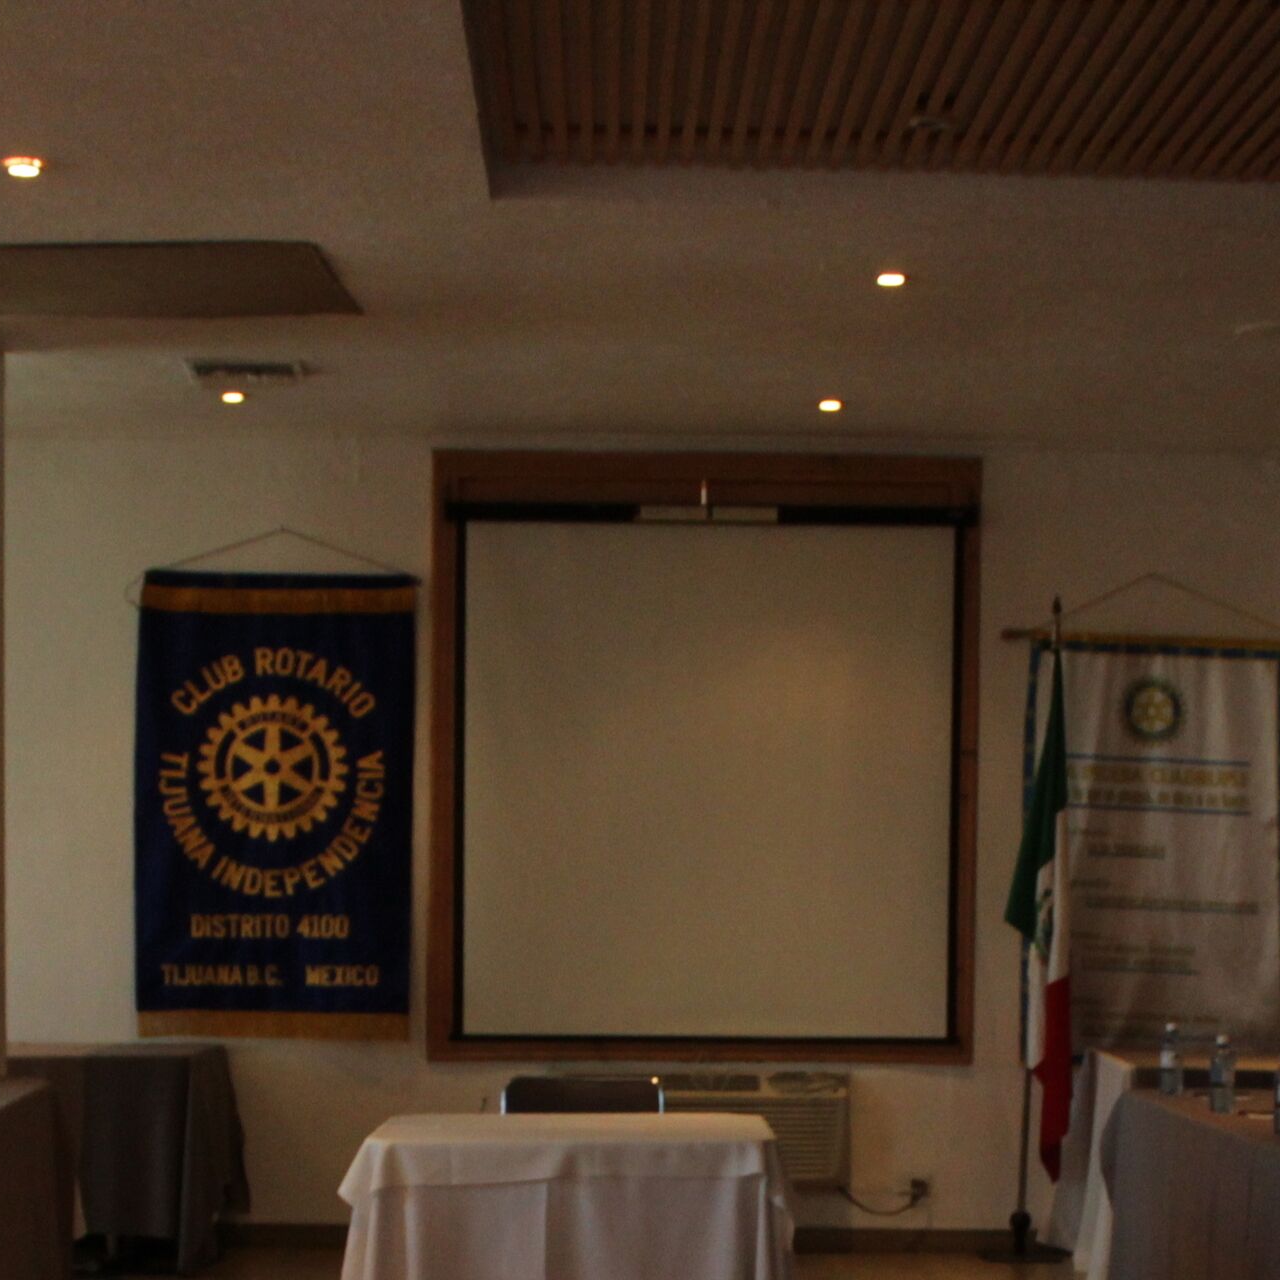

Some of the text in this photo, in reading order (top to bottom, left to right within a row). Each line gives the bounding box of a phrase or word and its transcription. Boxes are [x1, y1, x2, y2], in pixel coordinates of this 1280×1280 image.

[170, 646, 377, 719] CLUB ROTARIO
[158, 750, 386, 898] TIJUANA INDEPENDENCIA
[189, 913, 352, 939] DISTRITO 4100
[160, 963, 242, 987] TIJUANA
[304, 963, 382, 987] MEXICO
